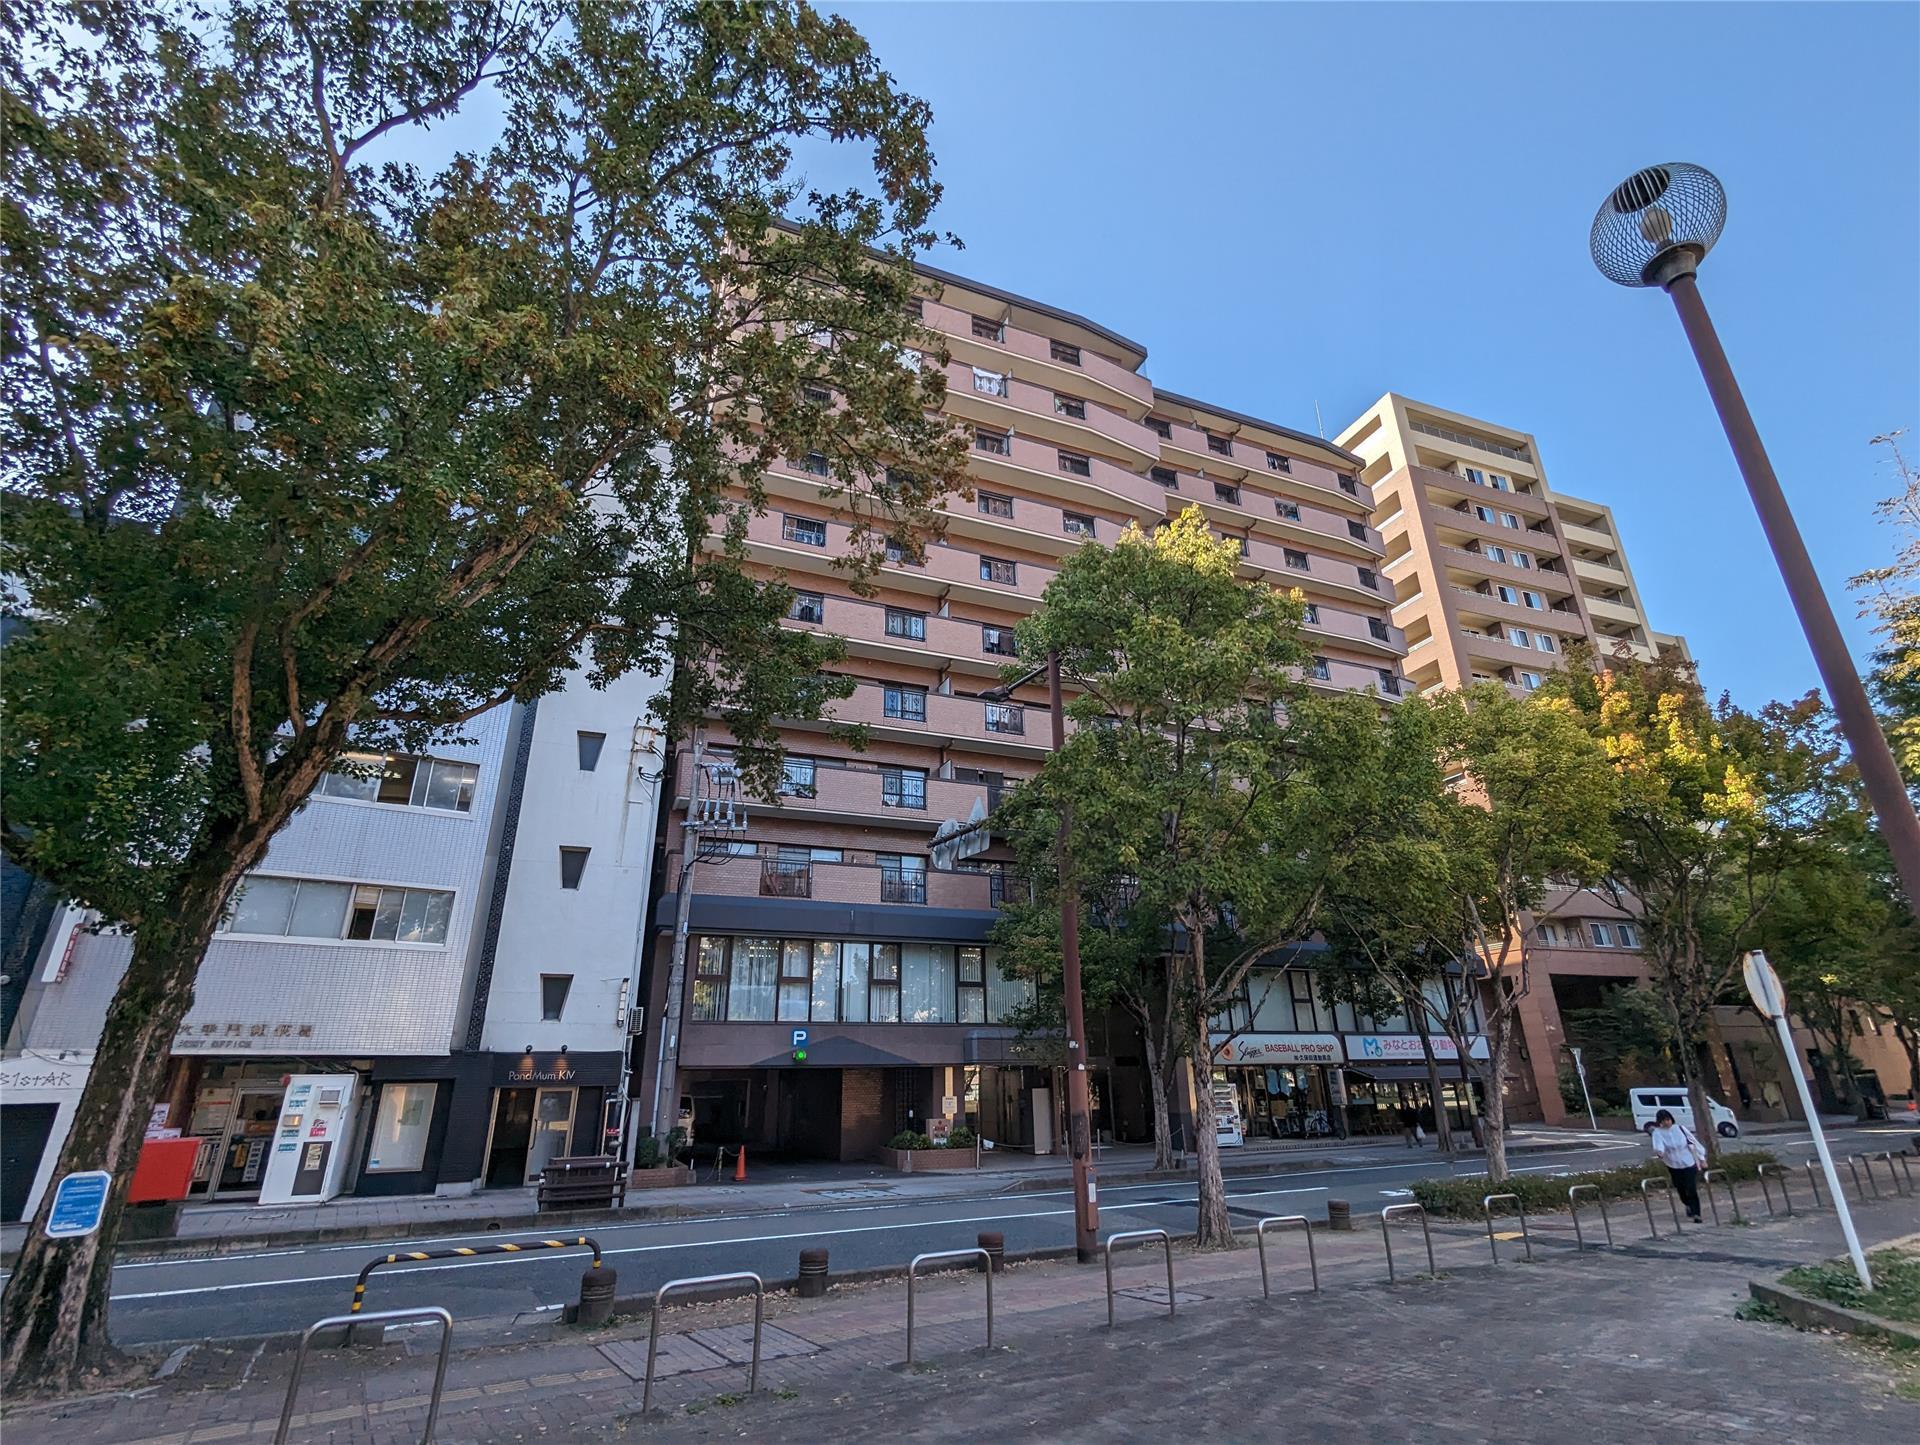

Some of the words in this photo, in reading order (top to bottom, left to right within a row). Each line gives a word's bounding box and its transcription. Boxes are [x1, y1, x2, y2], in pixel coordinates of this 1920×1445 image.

[793, 1030, 807, 1046] P
[210, 1040, 253, 1048] OFFICE
[1264, 1044, 1301, 1053] BASEBALL
[1301, 1044, 1317, 1053] PRO
[1317, 1044, 1335, 1053] SHOP
